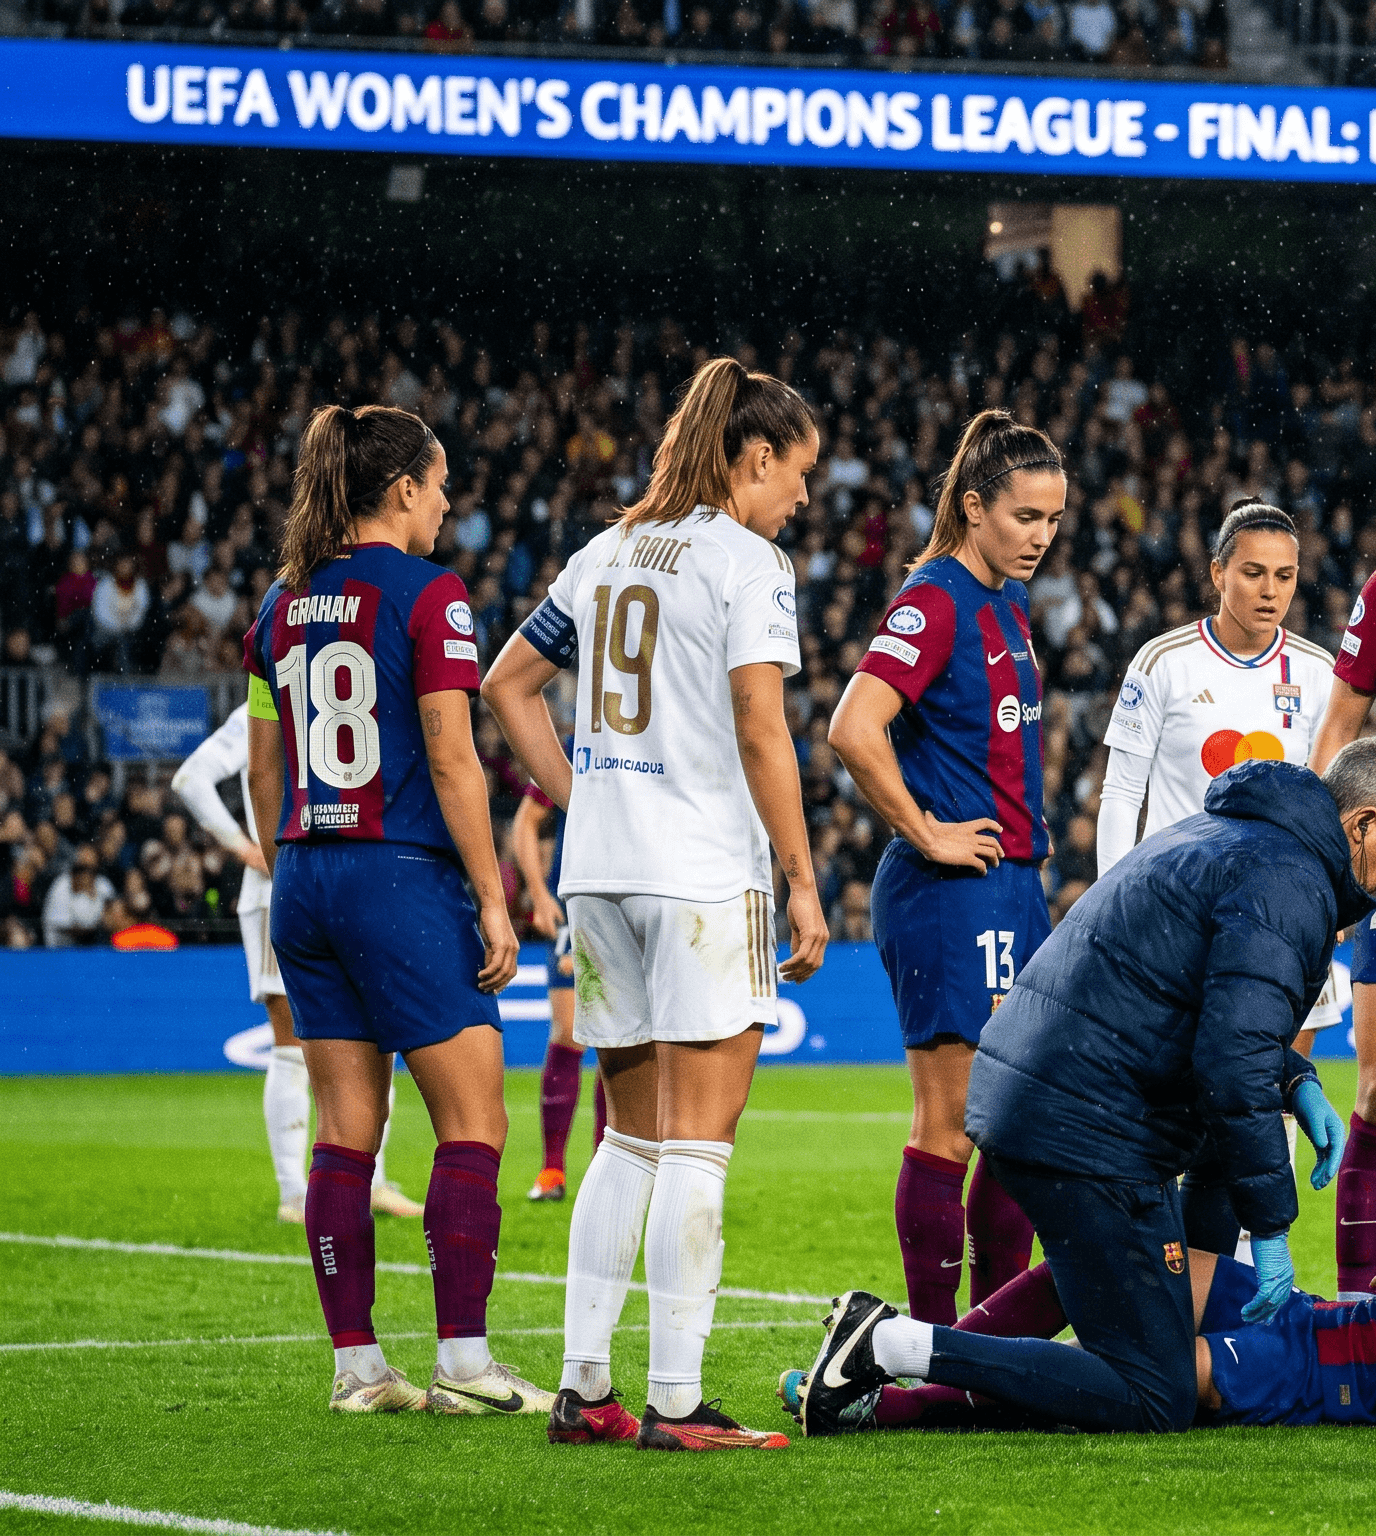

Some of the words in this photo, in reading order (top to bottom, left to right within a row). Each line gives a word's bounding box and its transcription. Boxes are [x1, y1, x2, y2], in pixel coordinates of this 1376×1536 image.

[127, 64, 280, 128] UEFA
[288, 70, 572, 139] WOMEN'S
[581, 81, 922, 150] CHAMPIONS
[932, 95, 1147, 157] LEAGUE
[1154, 123, 1180, 142] -
[1189, 103, 1360, 164] FINAL:
[591, 584, 660, 736] 19
[1276, 696, 1299, 712] OL
[275, 640, 381, 790] 18
[976, 930, 1015, 991] 13
